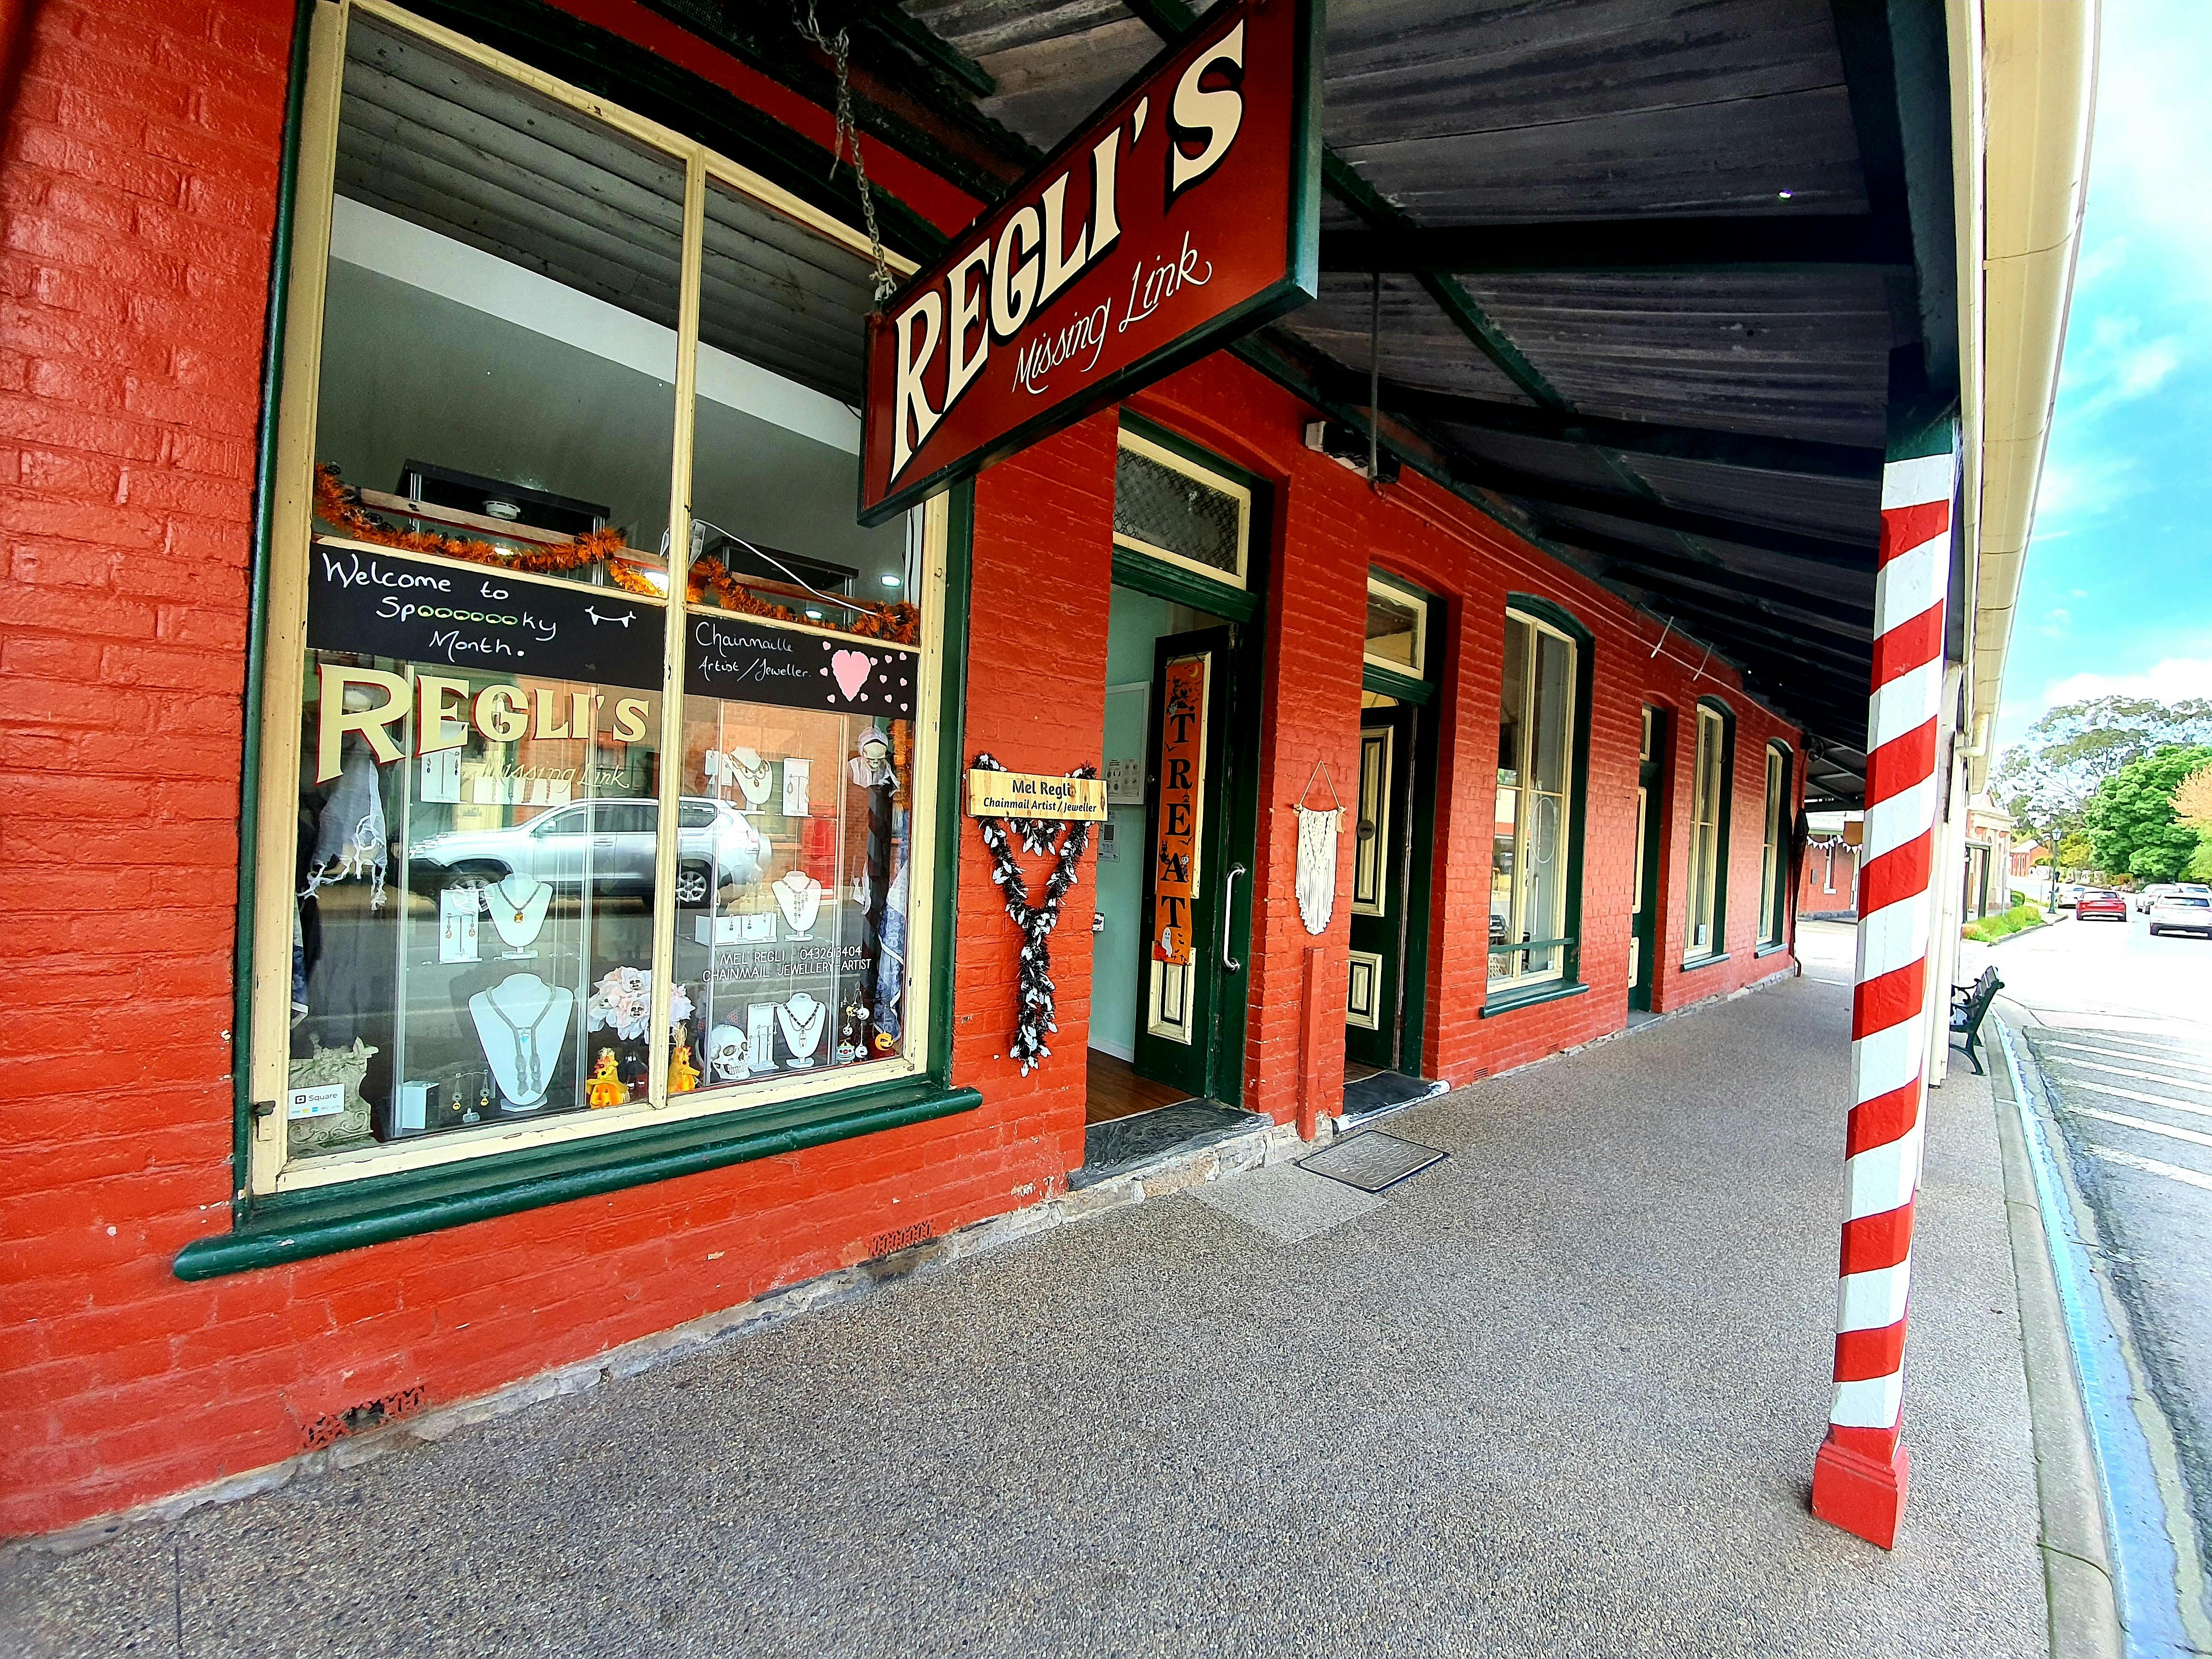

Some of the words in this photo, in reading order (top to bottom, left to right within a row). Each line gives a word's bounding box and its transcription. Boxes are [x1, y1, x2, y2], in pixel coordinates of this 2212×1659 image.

[889, 18, 1244, 484] REGLI'S
[1012, 297, 1112, 395] Missing
[1118, 230, 1213, 333] Link
[322, 552, 452, 592] Welcome
[480, 580, 509, 600] to
[376, 595, 557, 642] Spooooooky
[428, 630, 526, 662] Month.
[696, 621, 793, 658] Chainmaille
[315, 663, 649, 786] REGLI'S
[576, 762, 630, 789] Link
[1012, 780, 1036, 794] Mel
[1040, 781, 1072, 800] Regli
[984, 797, 1030, 809] Chainmail
[1031, 800, 1056, 811] Artist
[1064, 802, 1097, 813] Jeweller
[1159, 712, 1196, 929] TREAT
[720, 952, 749, 966] MEL
[754, 950, 785, 963] REGLI
[799, 945, 863, 961] 0432613404
[702, 966, 770, 982] CHAINMAIL
[308, 1093, 338, 1102] Square
